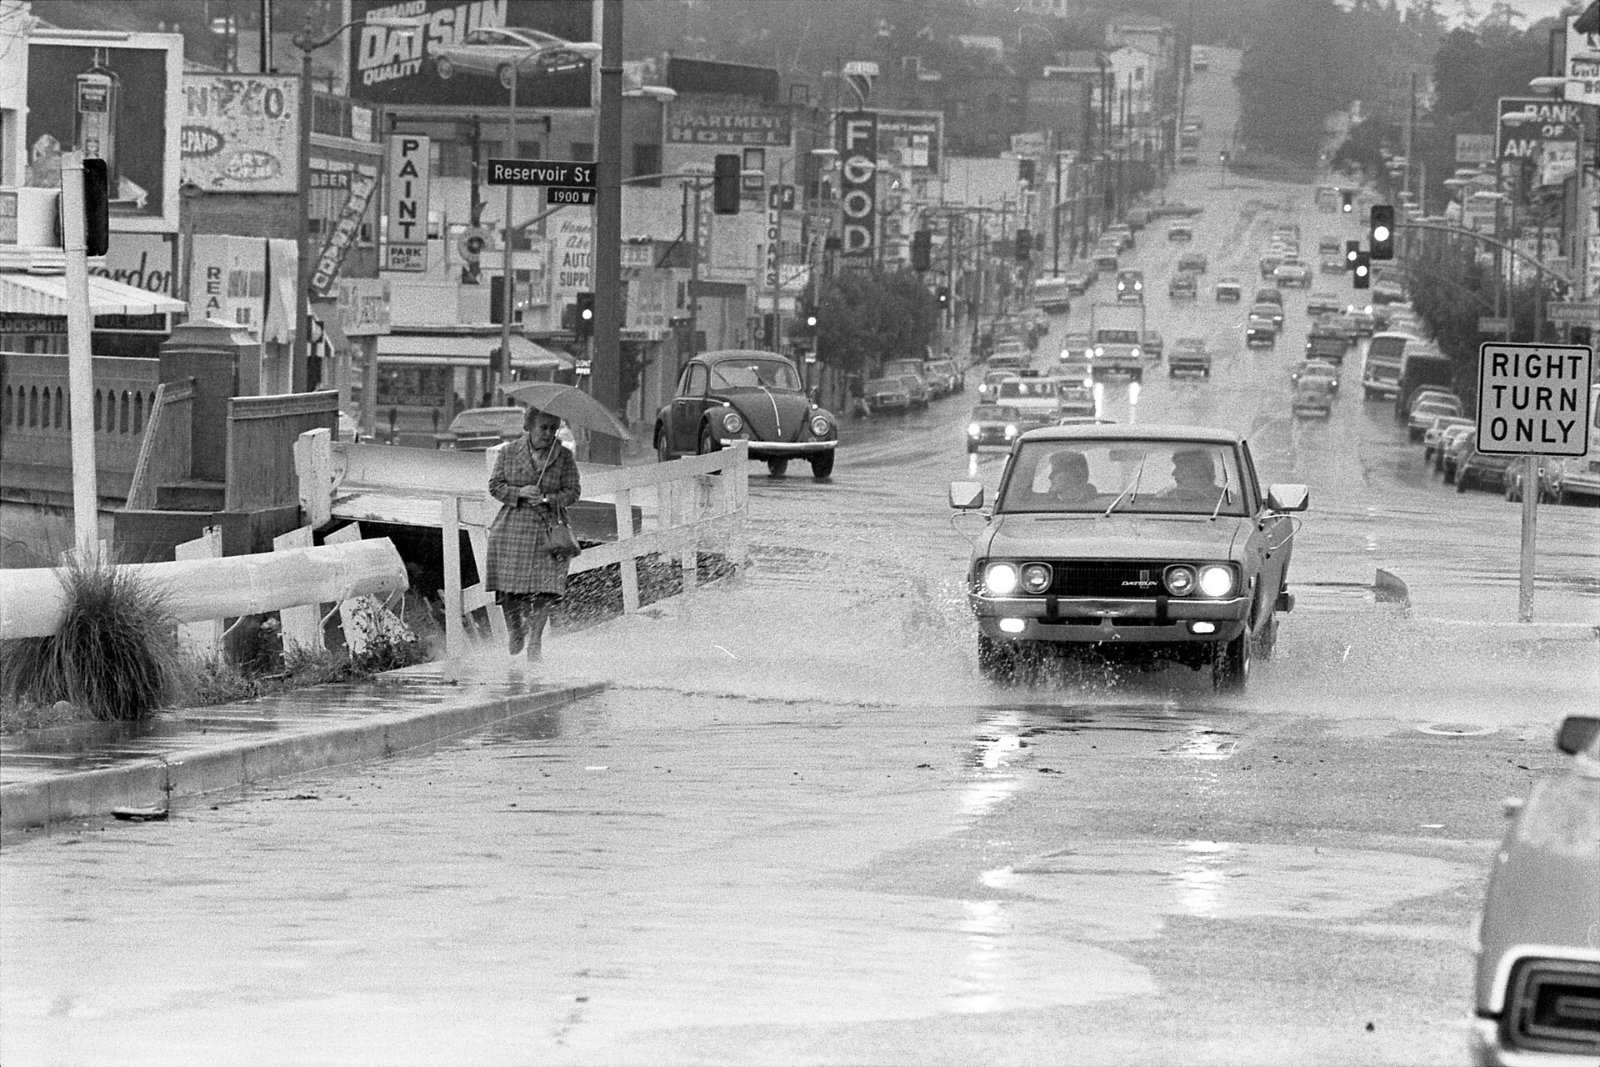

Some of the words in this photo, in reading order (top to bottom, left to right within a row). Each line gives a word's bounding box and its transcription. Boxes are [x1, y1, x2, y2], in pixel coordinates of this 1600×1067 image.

[358, 0, 508, 70] DATSUN
[363, 59, 422, 86] QUALITY
[1524, 104, 1581, 122] BANK
[672, 128, 777, 143] HOTEL
[1541, 125, 1565, 137] OF
[310, 174, 348, 187] BEER
[495, 165, 567, 181] Reservoir
[574, 167, 591, 182] St
[398, 140, 419, 239] PAINT
[554, 192, 580, 202] 1900
[581, 192, 590, 202] W
[843, 120, 876, 253] FOOD
[390, 248, 421, 256] PARK
[1492, 353, 1583, 379] RIGHT
[1492, 385, 1577, 411] TURN
[1491, 417, 1576, 443] ONLY
